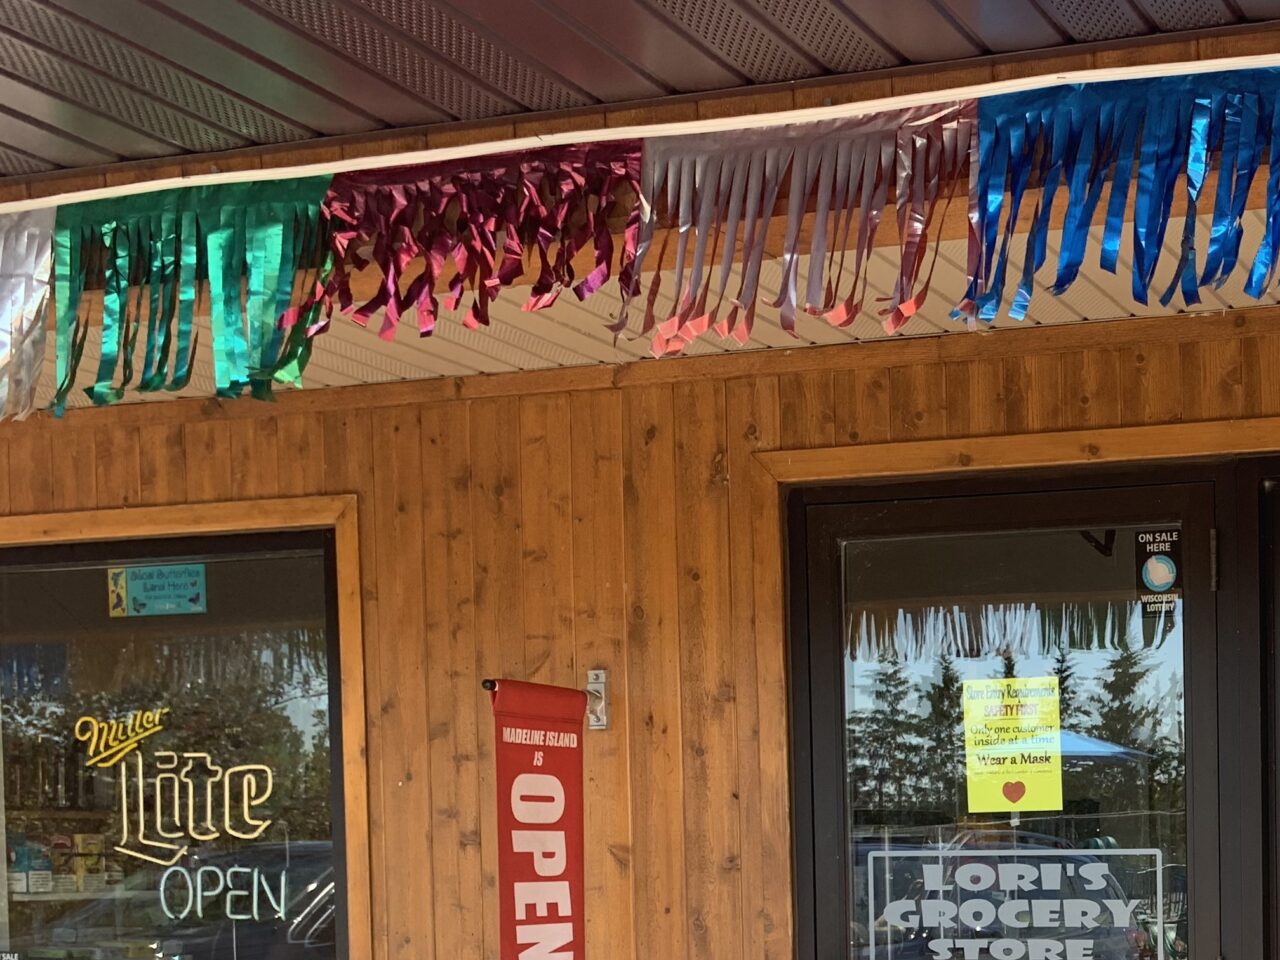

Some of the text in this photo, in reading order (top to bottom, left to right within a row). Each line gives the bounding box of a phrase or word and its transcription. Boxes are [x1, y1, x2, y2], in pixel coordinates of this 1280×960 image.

[1138, 531, 1179, 543] ON SALE
[1146, 542, 1172, 553] HERE
[1140, 593, 1179, 603] WISCONSIN
[1146, 602, 1175, 612] LOTTERY
[984, 703, 1039, 717] SAFETY FIRST
[74, 706, 171, 764] Miller
[503, 727, 578, 748] MADELINE ISLAND
[970, 723, 1054, 738] Only one customer
[973, 734, 1006, 747] inside
[1008, 735, 1018, 745] at
[1031, 734, 1055, 745] time
[532, 750, 544, 767] IS
[976, 750, 1052, 766] Wear a Mask
[114, 750, 273, 865] Lite
[922, 862, 1111, 892] LORI'S
[159, 864, 288, 922] OPEN
[883, 899, 1142, 928] GROCERY
[2, 953, 19, 960] SALE
